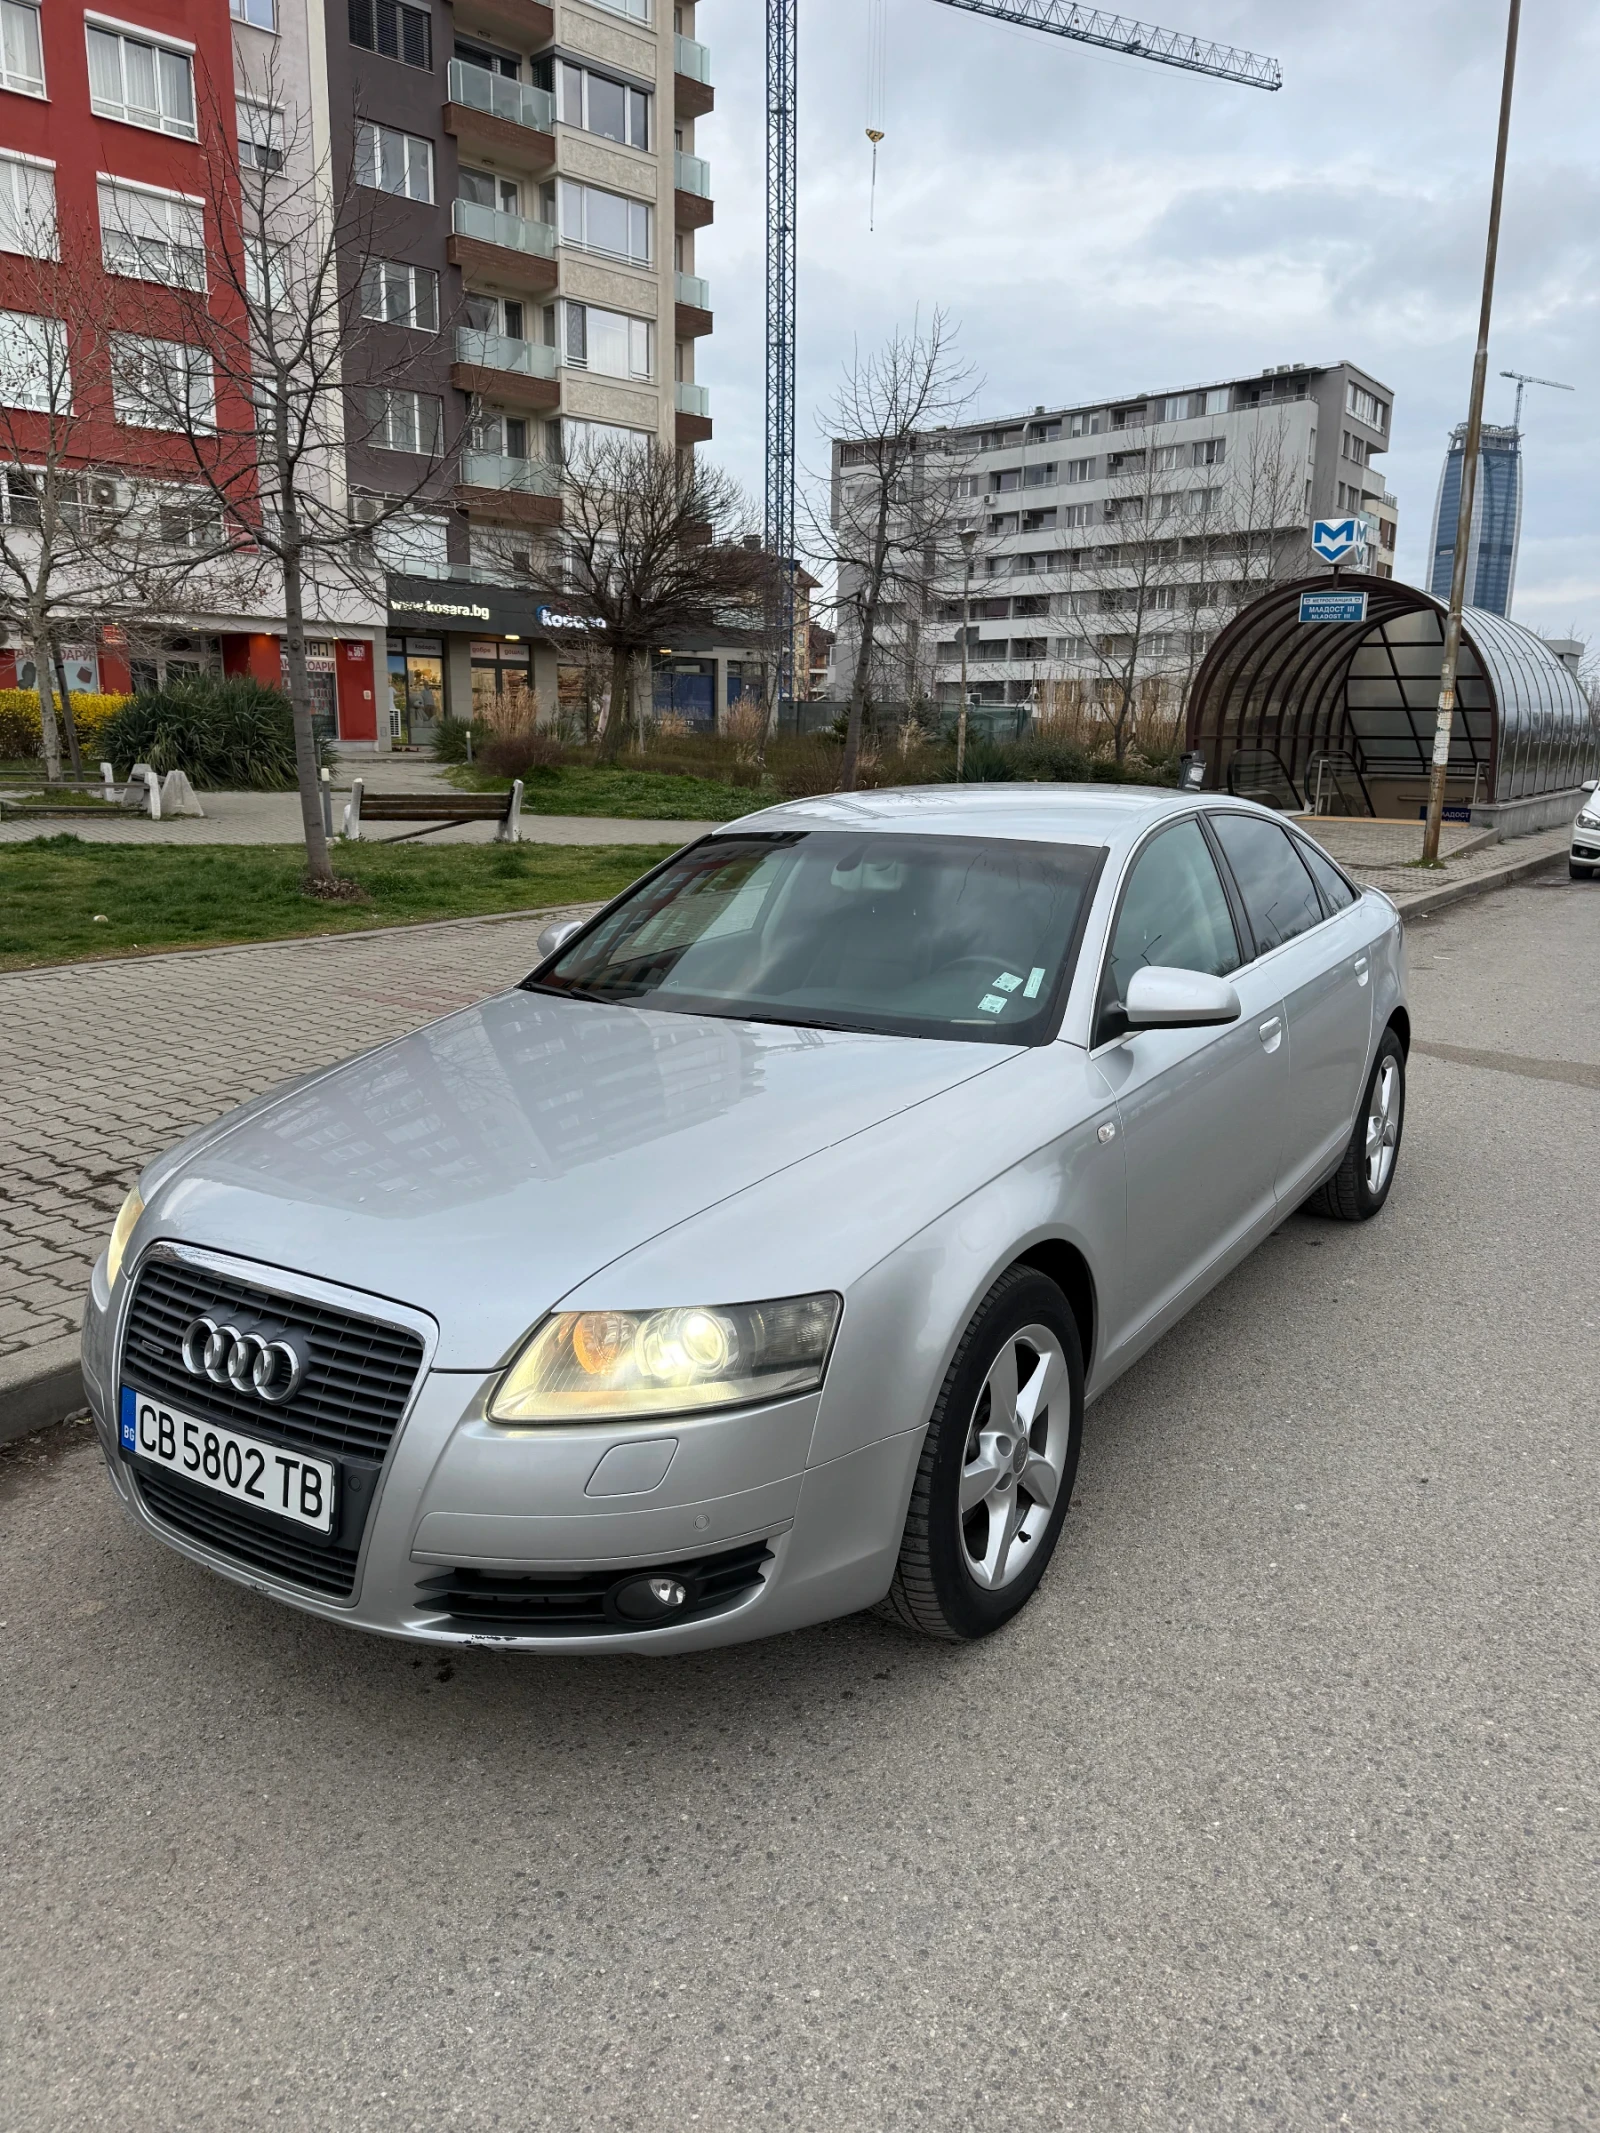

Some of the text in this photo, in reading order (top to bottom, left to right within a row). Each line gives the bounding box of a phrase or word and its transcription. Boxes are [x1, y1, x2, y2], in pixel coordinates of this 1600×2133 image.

[1309, 606, 1345, 614] МЛАДОСТ
[124, 1425, 135, 1441] BG
[140, 1404, 323, 1518] CB 5802 TB
